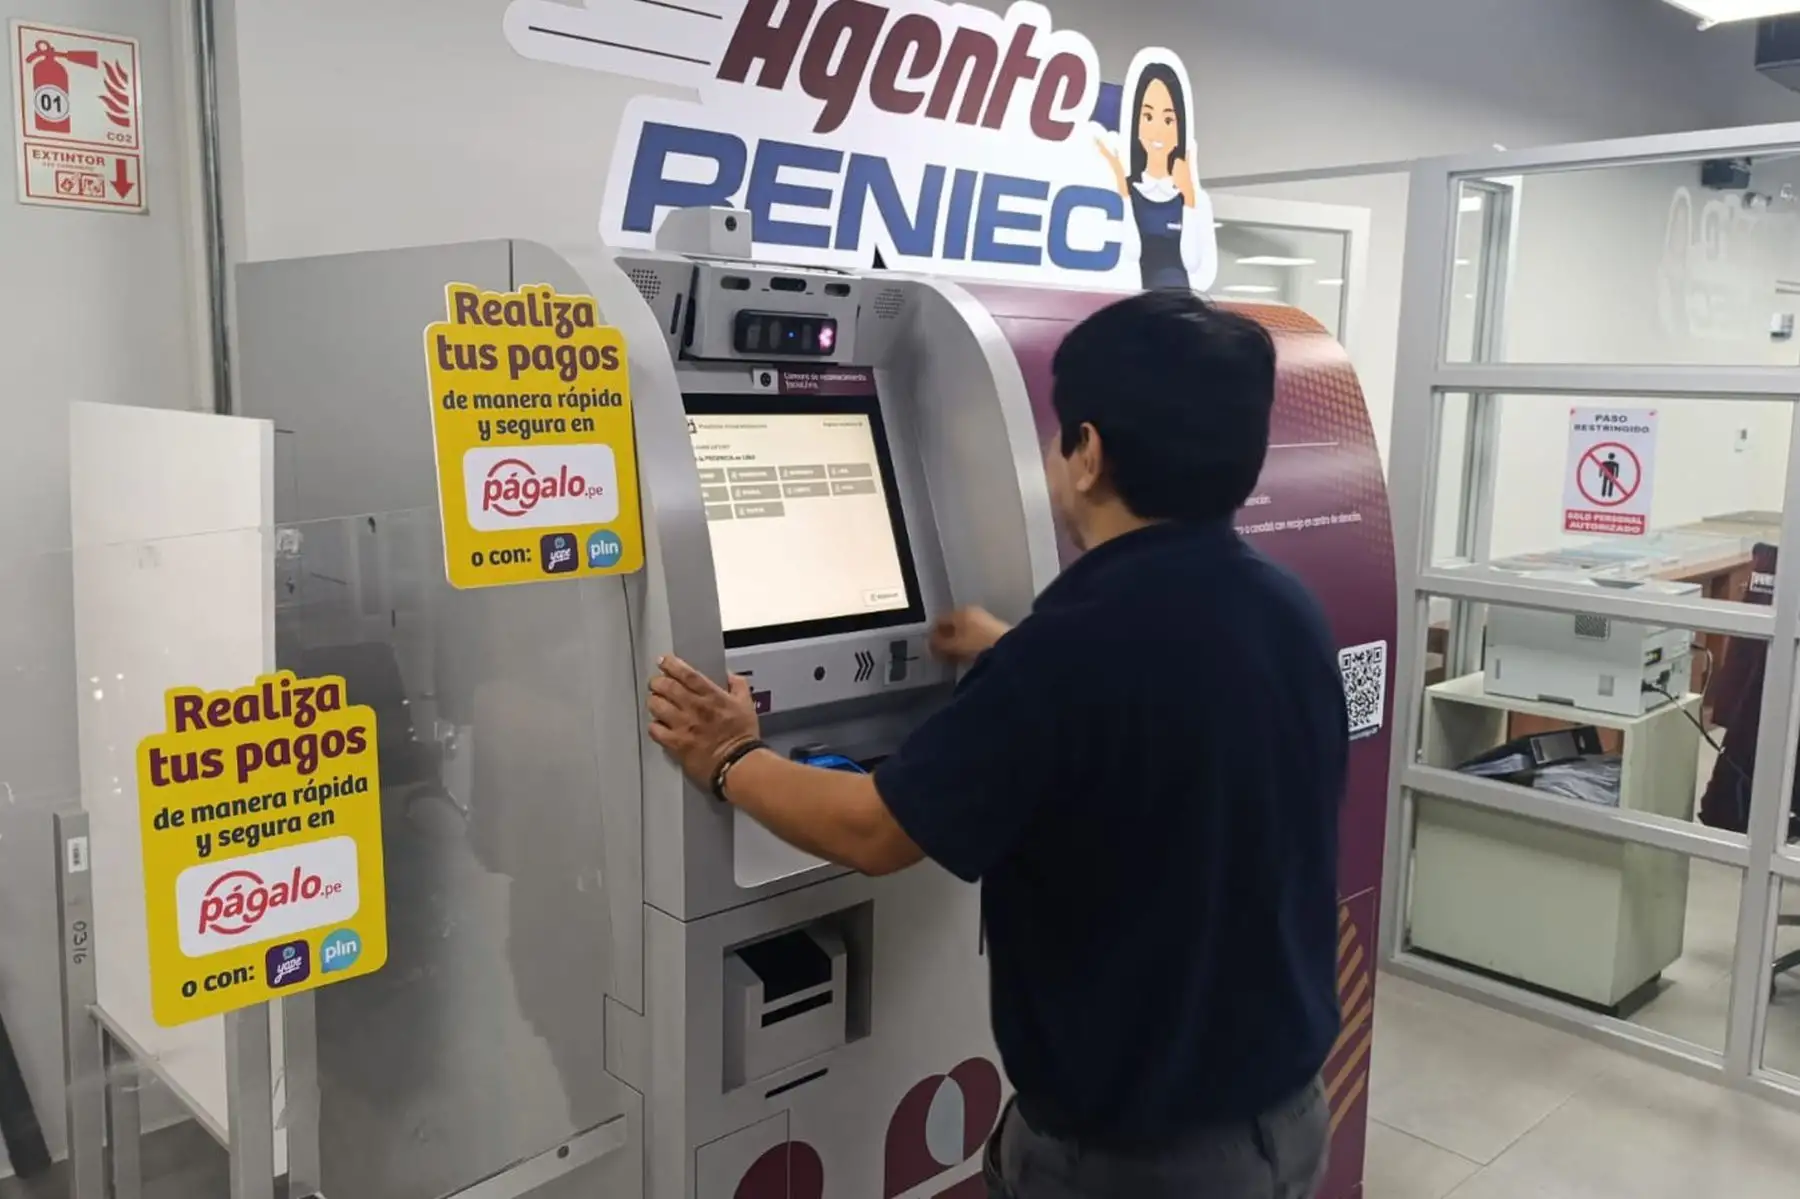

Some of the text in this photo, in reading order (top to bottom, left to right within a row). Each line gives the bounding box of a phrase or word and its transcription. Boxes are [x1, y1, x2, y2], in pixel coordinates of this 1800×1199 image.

[716, 0, 1088, 142] Agente
[41, 94, 62, 113] 01
[107, 131, 133, 143] CO2
[32, 149, 105, 166] EXTINTOR
[621, 121, 1124, 272] RENIEC
[454, 291, 594, 338] Realiza
[437, 334, 620, 382] tus pagos
[442, 386, 622, 412] de manera rápida
[478, 416, 595, 441] y segura en
[1573, 423, 1650, 434] RESTRINGIDO
[1595, 414, 1628, 423] PASO
[1567, 511, 1643, 524] SOLO PERSONAL
[1568, 521, 1641, 534] AUTORIZADO
[471, 550, 484, 567] o
[489, 547, 531, 566] con:
[590, 540, 619, 558] plin
[174, 678, 341, 733] Realiza
[150, 725, 367, 787] tus pagos
[153, 774, 368, 831] de manera rápida
[195, 809, 335, 857] y segura en
[182, 980, 197, 998] o
[204, 964, 255, 993] con:
[324, 939, 358, 964] plin
